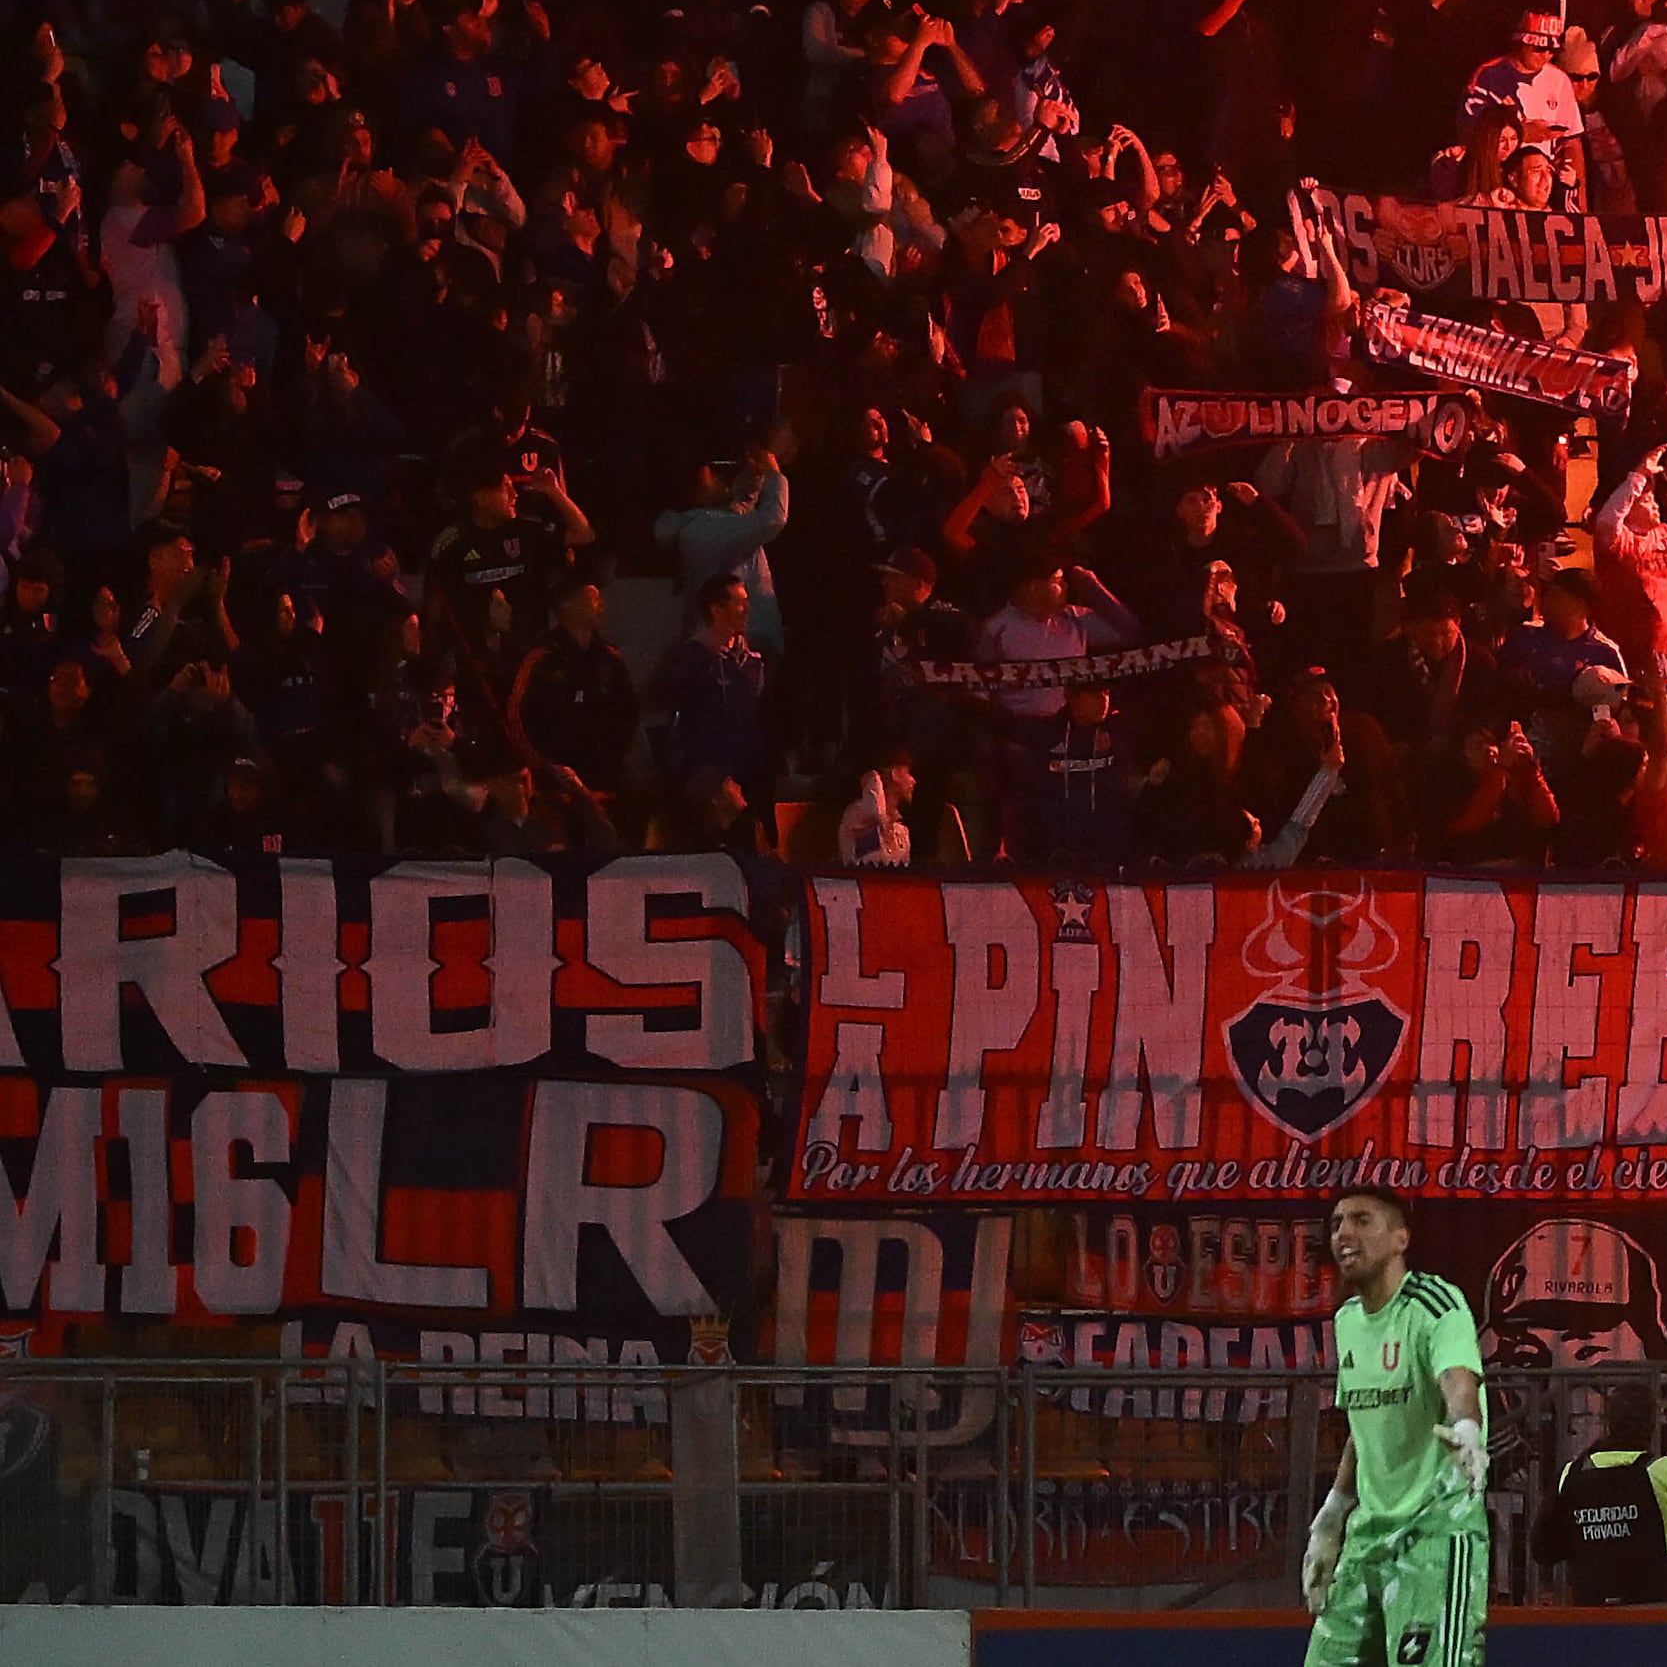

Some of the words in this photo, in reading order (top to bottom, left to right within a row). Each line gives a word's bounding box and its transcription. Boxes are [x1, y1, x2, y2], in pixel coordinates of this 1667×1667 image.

[1457, 206, 1618, 302] TALCA
[0, 849, 755, 1072] RIOS
[801, 1138, 877, 1192] Por
[888, 1146, 941, 1195] los
[946, 1144, 1152, 1194] hermanos
[1165, 1158, 1240, 1202] que
[1248, 1141, 1428, 1192] alientan
[1436, 1140, 1556, 1192] desde
[1564, 1140, 1600, 1192] el
[1184, 1213, 1330, 1313] ESPE
[1544, 1279, 1614, 1295] RIVAROLA
[1570, 1235, 1592, 1276] 7
[280, 1319, 386, 1410] LA
[418, 1330, 671, 1425] REINA
[1071, 1322, 1340, 1422] FARFAN
[1574, 1503, 1639, 1526] SEGURIDAD
[1582, 1521, 1632, 1542] PRIVADA
